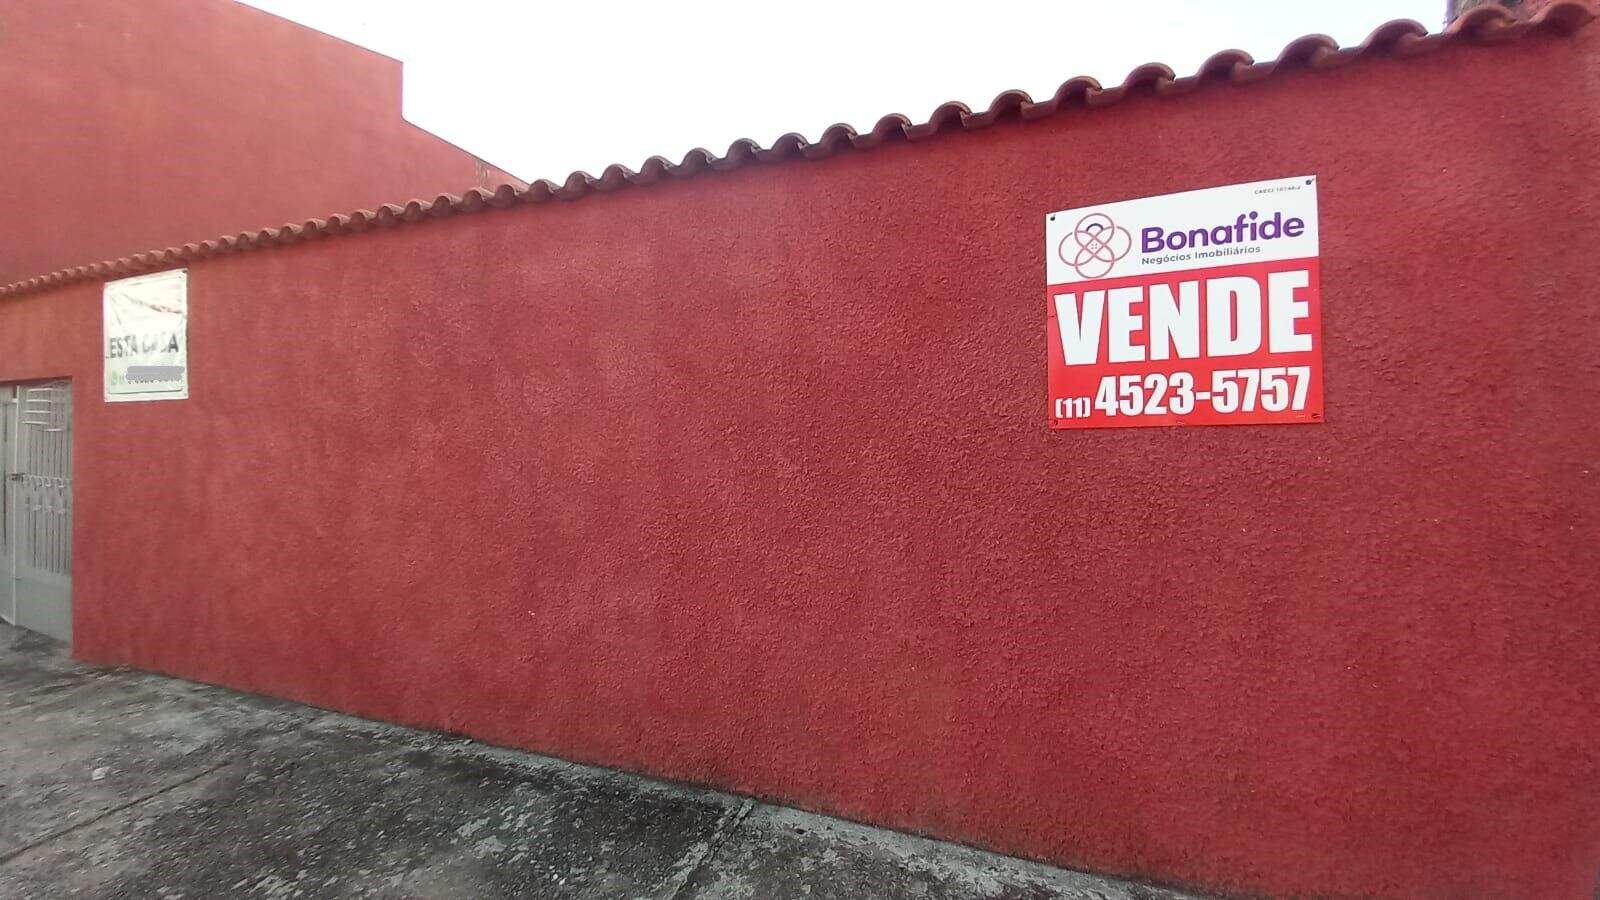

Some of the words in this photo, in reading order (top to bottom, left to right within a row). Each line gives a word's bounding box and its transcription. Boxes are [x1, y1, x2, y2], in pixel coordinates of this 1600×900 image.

[1141, 210, 1305, 254] Bonafide
[1141, 252, 1192, 266] Negócios
[1195, 245, 1261, 260] Imobiliários
[1053, 269, 1313, 366] VENDE
[1055, 396, 1091, 419] (11)
[1094, 365, 1311, 417] 4523-5757
